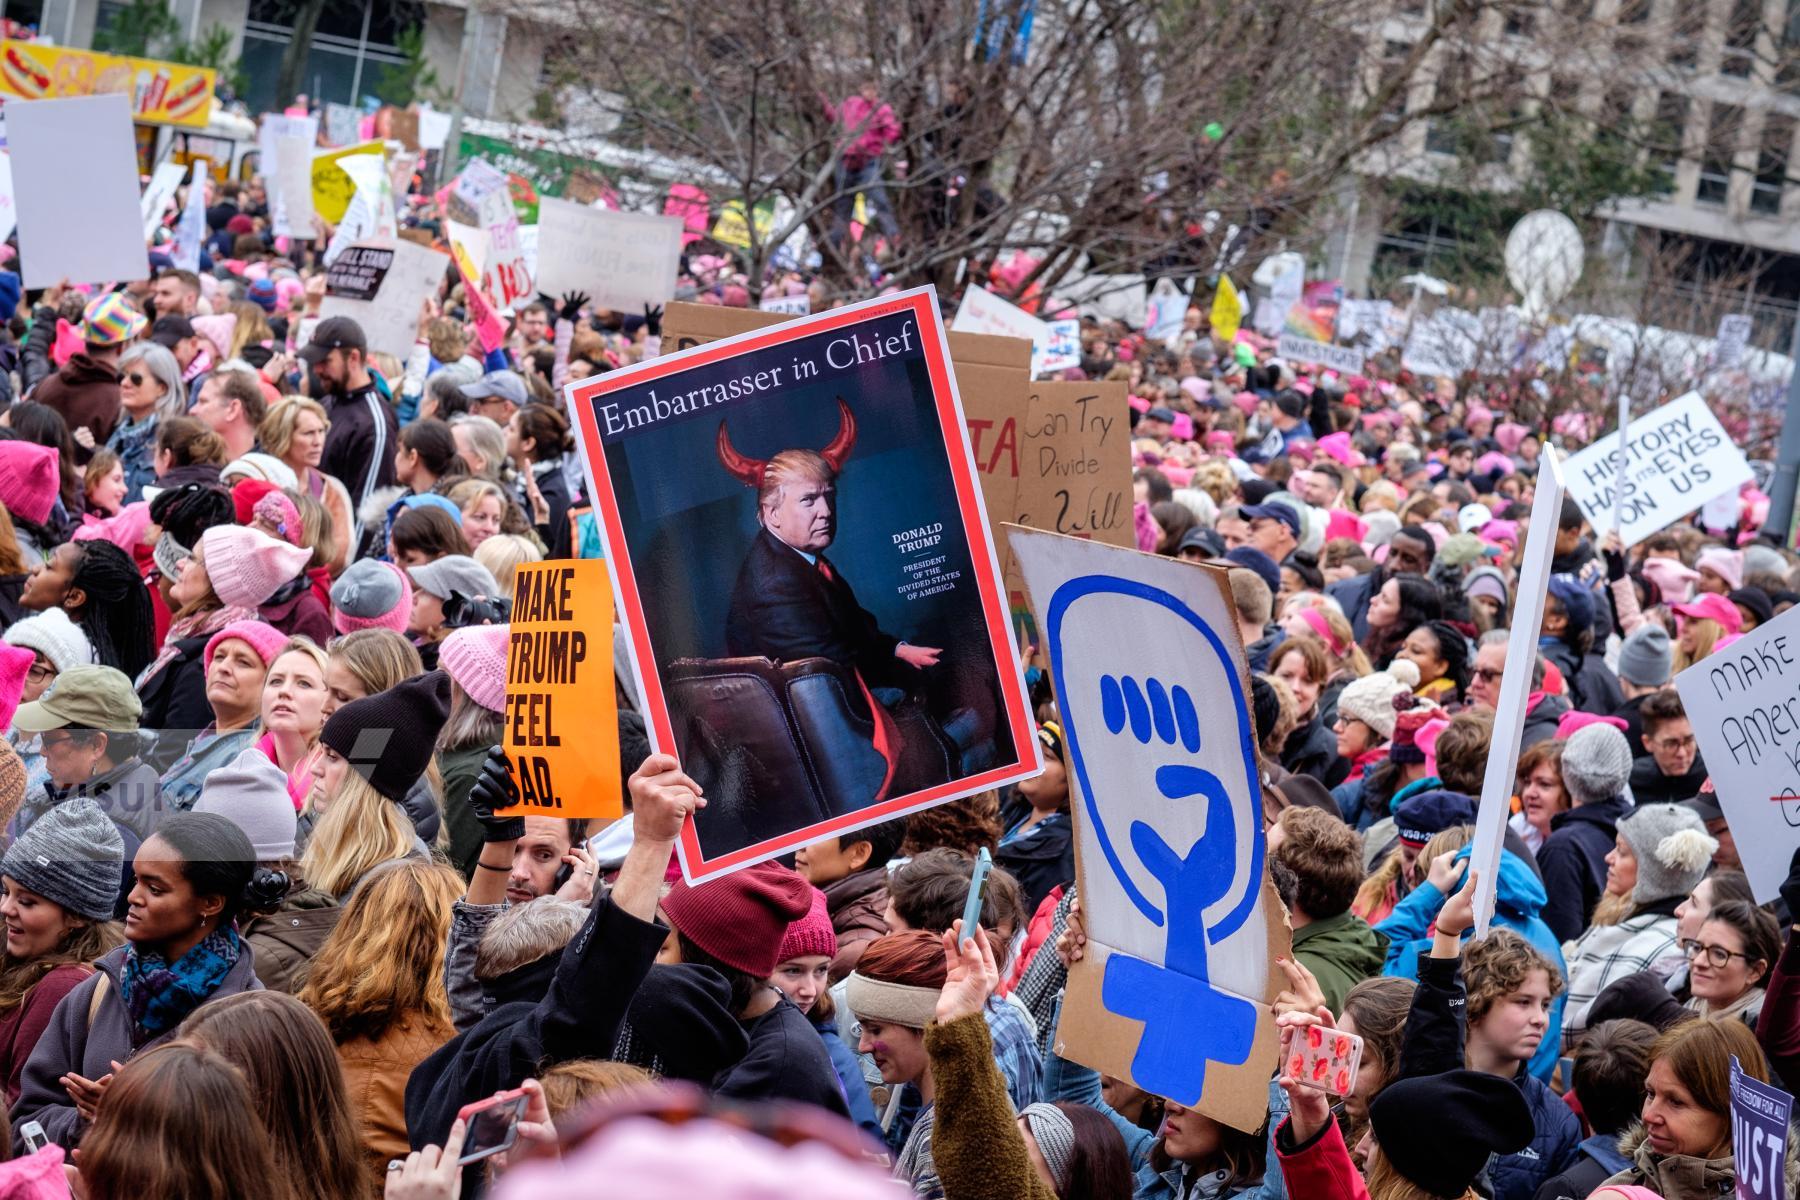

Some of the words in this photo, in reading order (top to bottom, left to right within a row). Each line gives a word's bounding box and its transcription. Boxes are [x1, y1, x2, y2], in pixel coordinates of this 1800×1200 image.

[600, 364, 783, 436] Embarrasser
[793, 356, 819, 381] in
[825, 320, 913, 370] Chief
[1075, 395, 1113, 446] Try
[1039, 446, 1100, 477] Divide
[1582, 413, 1693, 486] HISTORY
[1652, 428, 1721, 474] EYES
[1619, 491, 1658, 525] ON
[1669, 463, 1711, 494] US
[892, 522, 943, 544] DONALD
[898, 534, 941, 554] TRUMP
[897, 579, 930, 594] DIVIDED
[931, 570, 960, 585] STATES
[903, 555, 946, 573] PRESIDENT
[913, 571, 924, 580] OF
[925, 566, 941, 577] THE
[512, 568, 575, 624] MAKE
[907, 592, 918, 601] OF
[919, 582, 955, 598] AMERICA
[508, 630, 587, 685] TRUMP
[1710, 636, 1794, 701] MAKE
[505, 693, 561, 747] FEEL
[1740, 1086, 1761, 1110] FREEDOM
[1761, 1101, 1774, 1115] FOR
[1774, 1104, 1785, 1120] ALL
[1730, 1102, 1783, 1200] RUST
